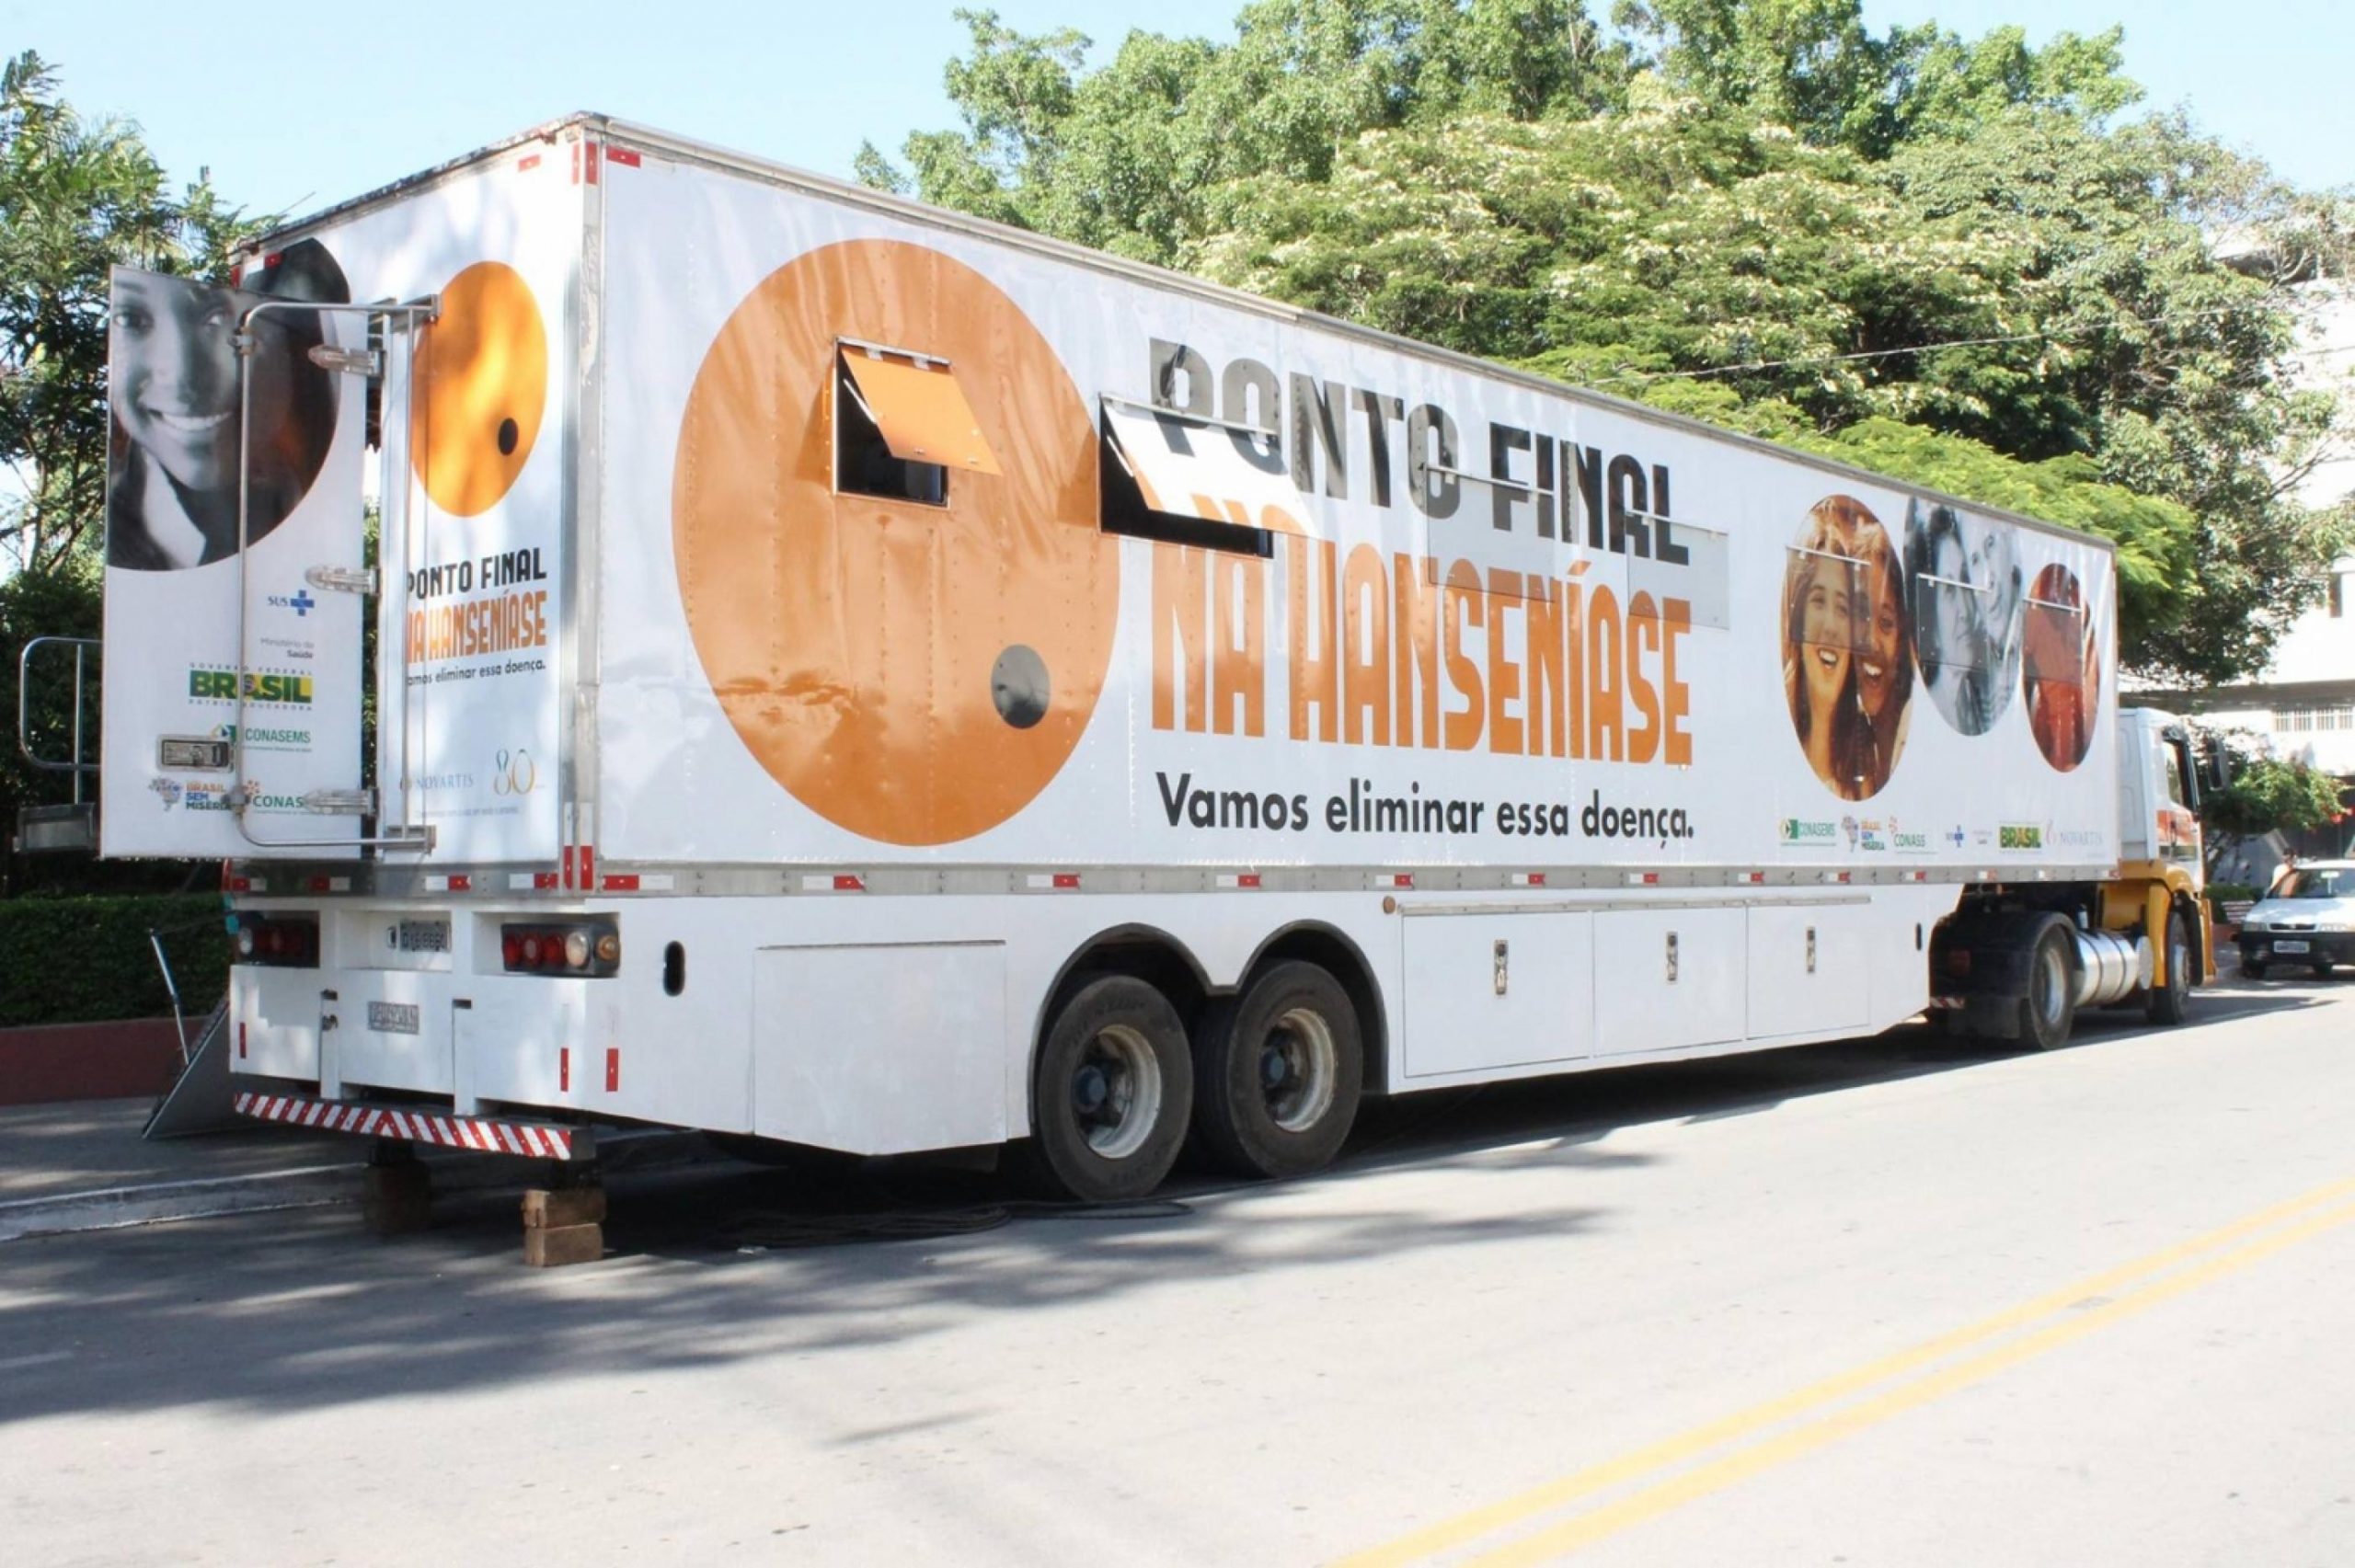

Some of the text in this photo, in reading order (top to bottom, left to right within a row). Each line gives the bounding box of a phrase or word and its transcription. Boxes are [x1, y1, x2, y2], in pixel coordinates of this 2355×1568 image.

[1150, 338, 1689, 566] PONTO FINAL
[481, 547, 546, 589] FINAL
[267, 596, 288, 607] SUS
[429, 589, 547, 661] HANSENÍASE
[1152, 497, 1692, 765] NA HANSENÍASE
[408, 658, 546, 687] amos eliminar essa doença.
[190, 670, 313, 704] BRASIL
[245, 727, 312, 744] CONASEMS
[187, 782, 225, 793] BRASIL
[187, 792, 209, 801] SEM
[253, 795, 304, 808] CONAS
[1156, 772, 1694, 849] Vamos eliminar essa doença.
[1893, 833, 1926, 847] CONASS
[2000, 826, 2041, 848] BRASIL
